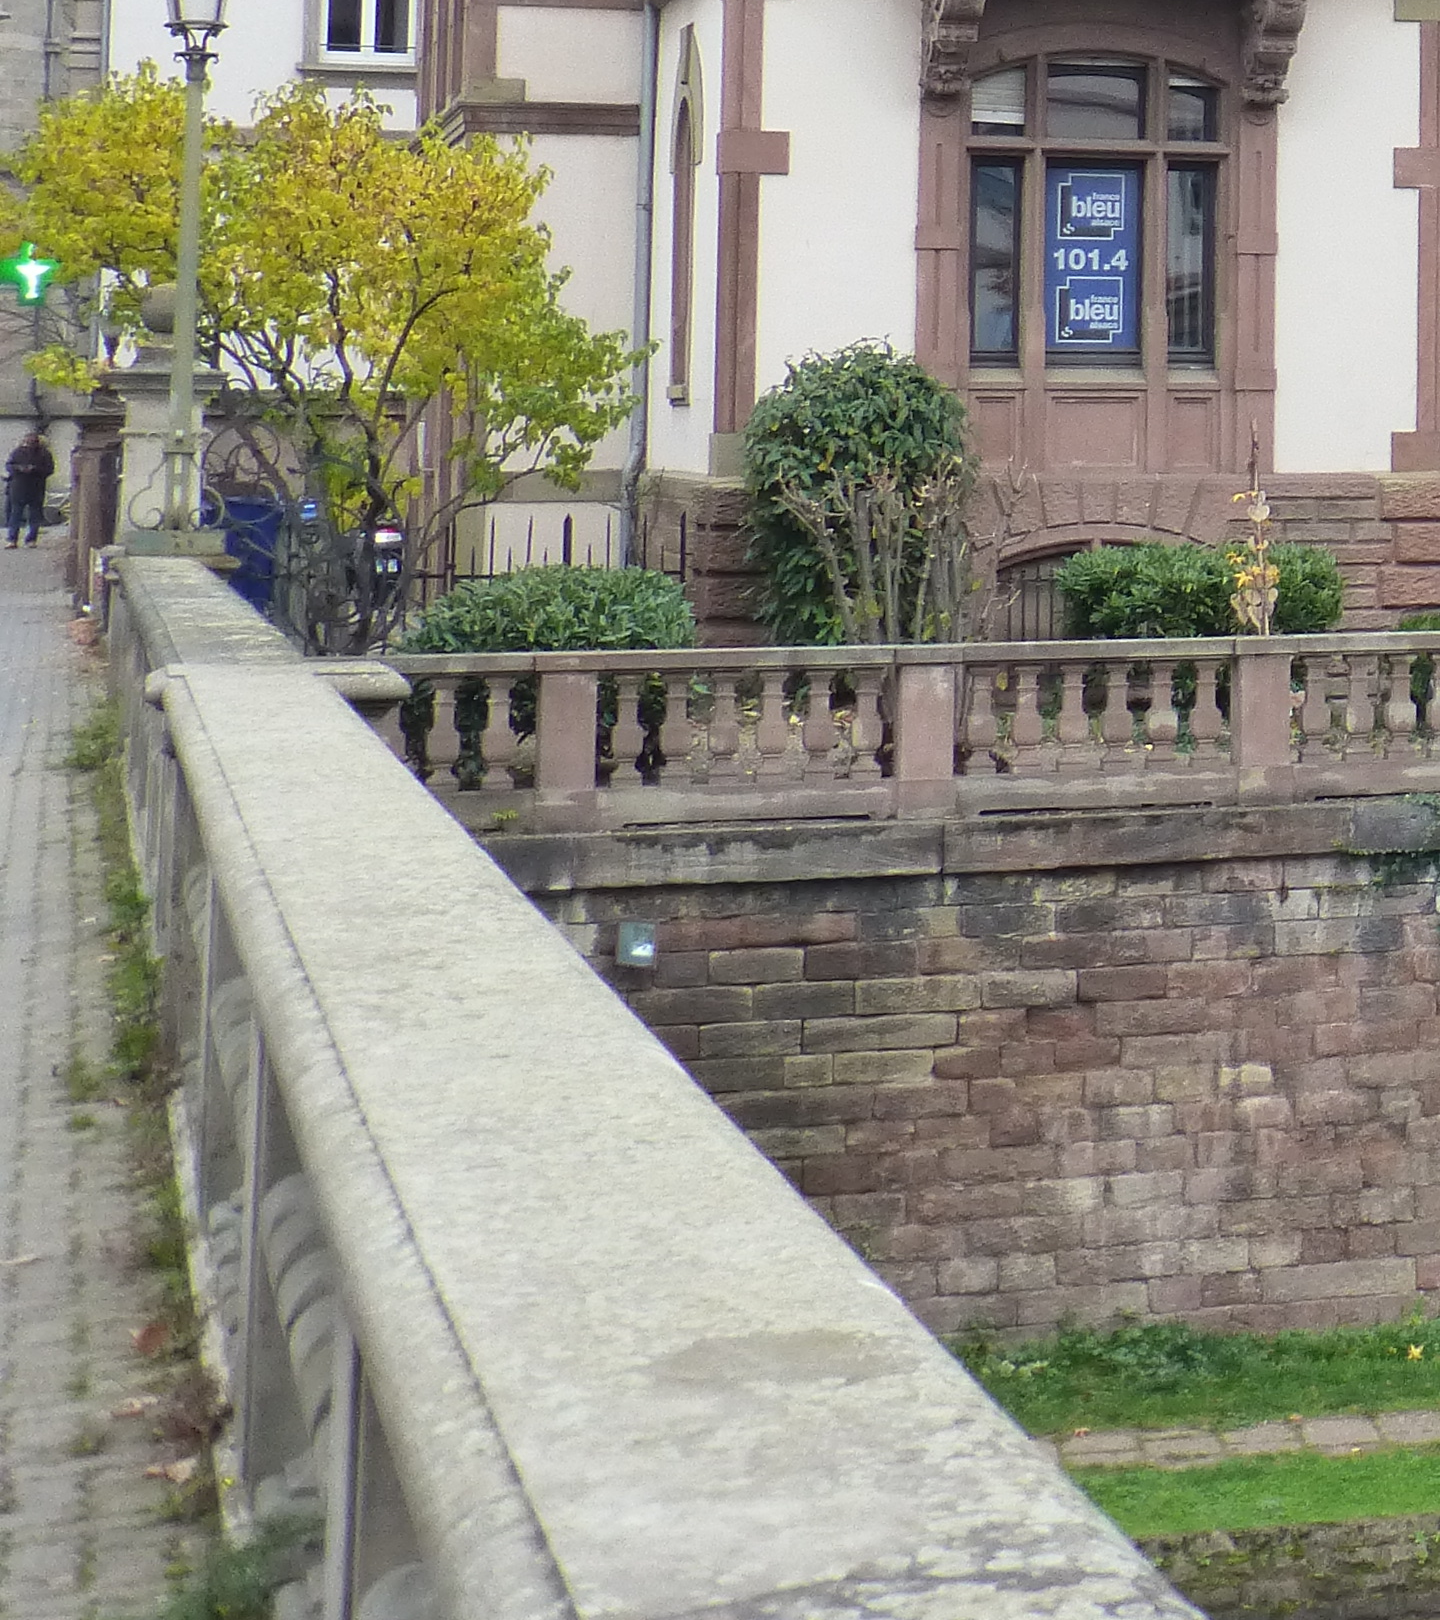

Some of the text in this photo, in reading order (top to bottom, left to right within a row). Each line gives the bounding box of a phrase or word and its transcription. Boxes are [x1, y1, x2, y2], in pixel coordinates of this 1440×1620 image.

[1071, 196, 1121, 218] bleu
[1053, 248, 1129, 271] 101.4
[1069, 298, 1119, 321] bleu
